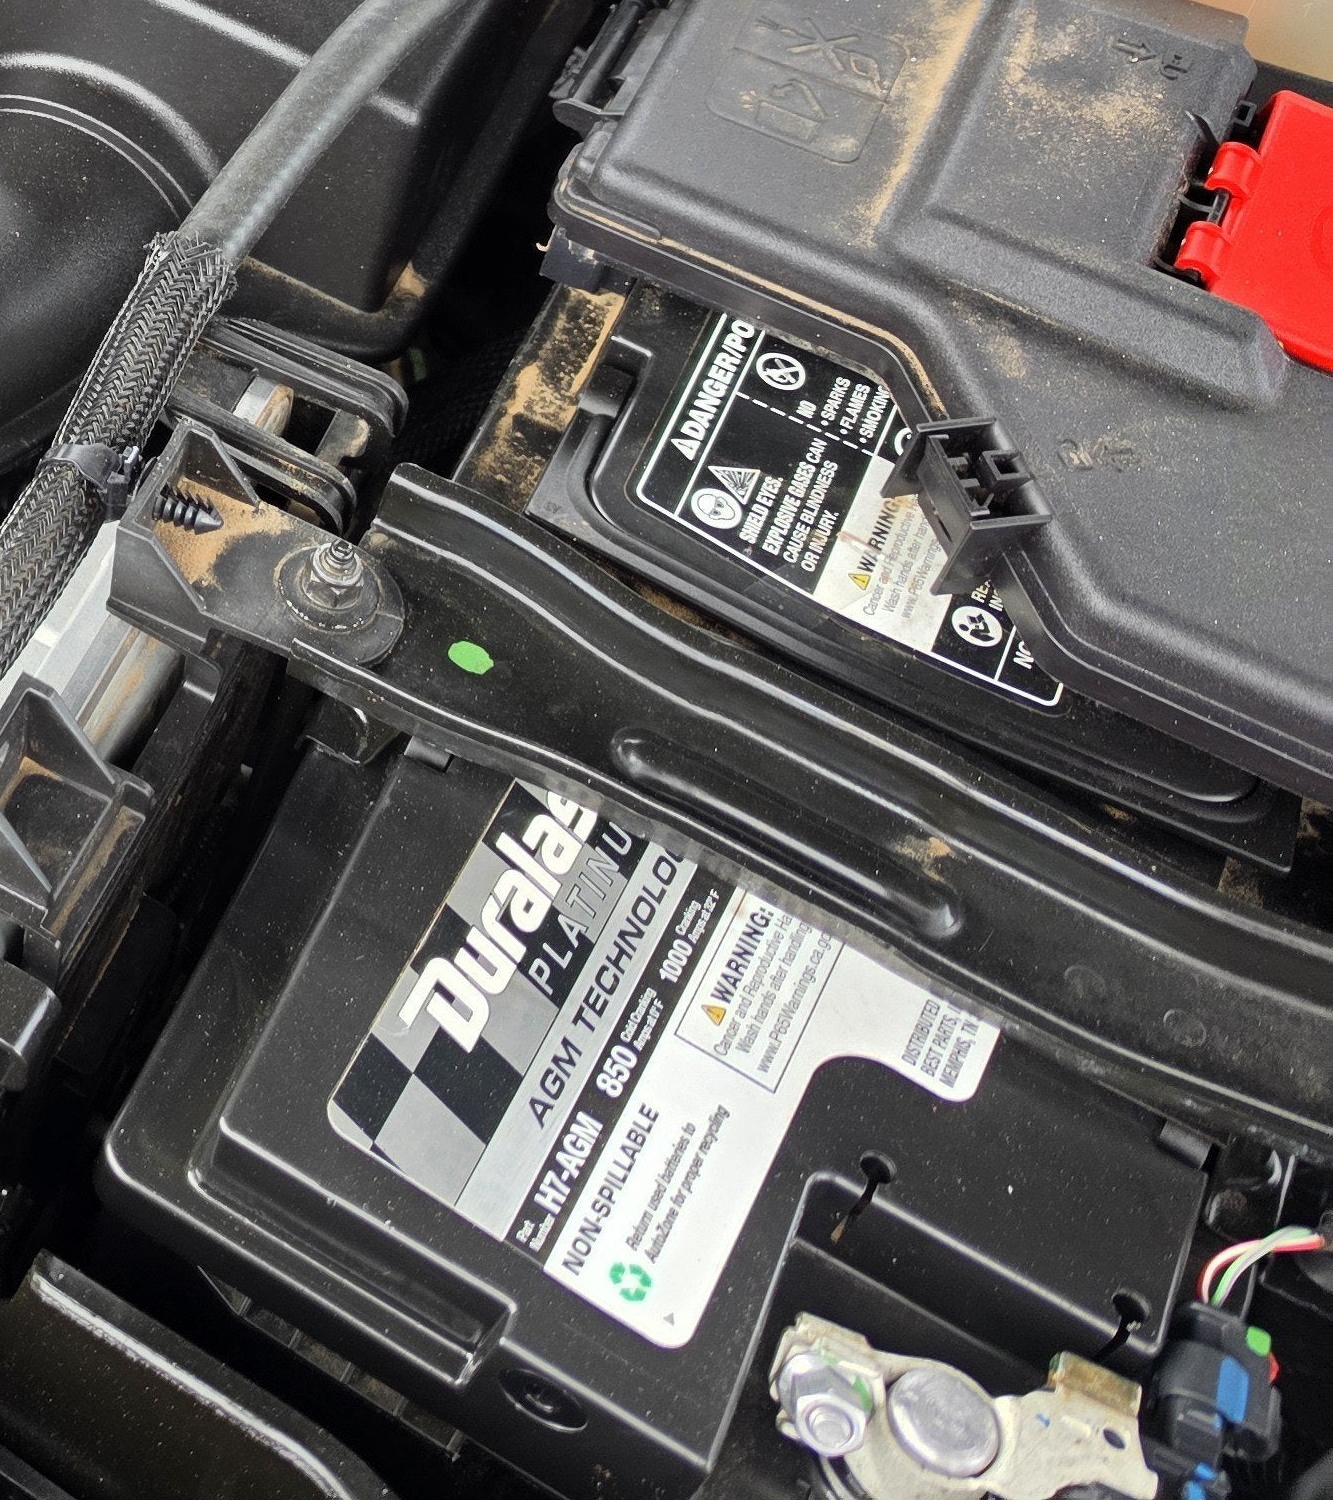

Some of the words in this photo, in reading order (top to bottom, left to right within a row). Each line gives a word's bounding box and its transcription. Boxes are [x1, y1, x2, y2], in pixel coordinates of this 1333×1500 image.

[796, 400, 816, 418] NO
[821, 377, 850, 420] SPARKS
[840, 384, 870, 429] FLAMES
[739, 504, 768, 544] SHIELD
[756, 476, 783, 506] EYES.
[762, 495, 801, 555] EXPLOSIVE
[788, 462, 815, 498] GASES
[806, 438, 827, 463] CAN
[783, 522, 810, 562] CAUSE
[800, 460, 837, 524] BLINDNESS
[801, 552, 819, 571] OR
[809, 510, 839, 553] INJURY.
[884, 510, 915, 566] Reproductive
[861, 580, 888, 618] Cancer
[878, 565, 892, 583] and
[883, 586, 902, 612] Wash
[893, 559, 913, 587] hands
[905, 538, 922, 559] after
[529, 1038, 581, 1128] AGM
[572, 844, 685, 1032] TECHNOLO
[660, 939, 692, 982] 1000
[711, 908, 773, 1003] WARNING:
[742, 930, 783, 997] Reproductive
[714, 1018, 741, 1055] Cancer
[735, 994, 752, 1018] and
[735, 1024, 760, 1053] Wash
[751, 986, 776, 1024] hands
[770, 965, 787, 991] after
[902, 1000, 940, 1066] DISTRIBUTED
[961, 1020, 977, 1035] TN
[921, 1047, 942, 1076] BEST
[534, 1112, 603, 1214] H7-AGM
[597, 1046, 637, 1097] 850
[563, 1104, 658, 1275] NON-SPILLABLE
[623, 1204, 656, 1252] Return
[643, 1177, 669, 1212] used
[656, 1131, 693, 1184] batteries
[681, 1119, 699, 1137] to
[640, 1203, 681, 1264] AutoZone
[667, 1187, 688, 1210] for
[678, 1152, 708, 1194] proper
[694, 1102, 733, 1157] recycling
